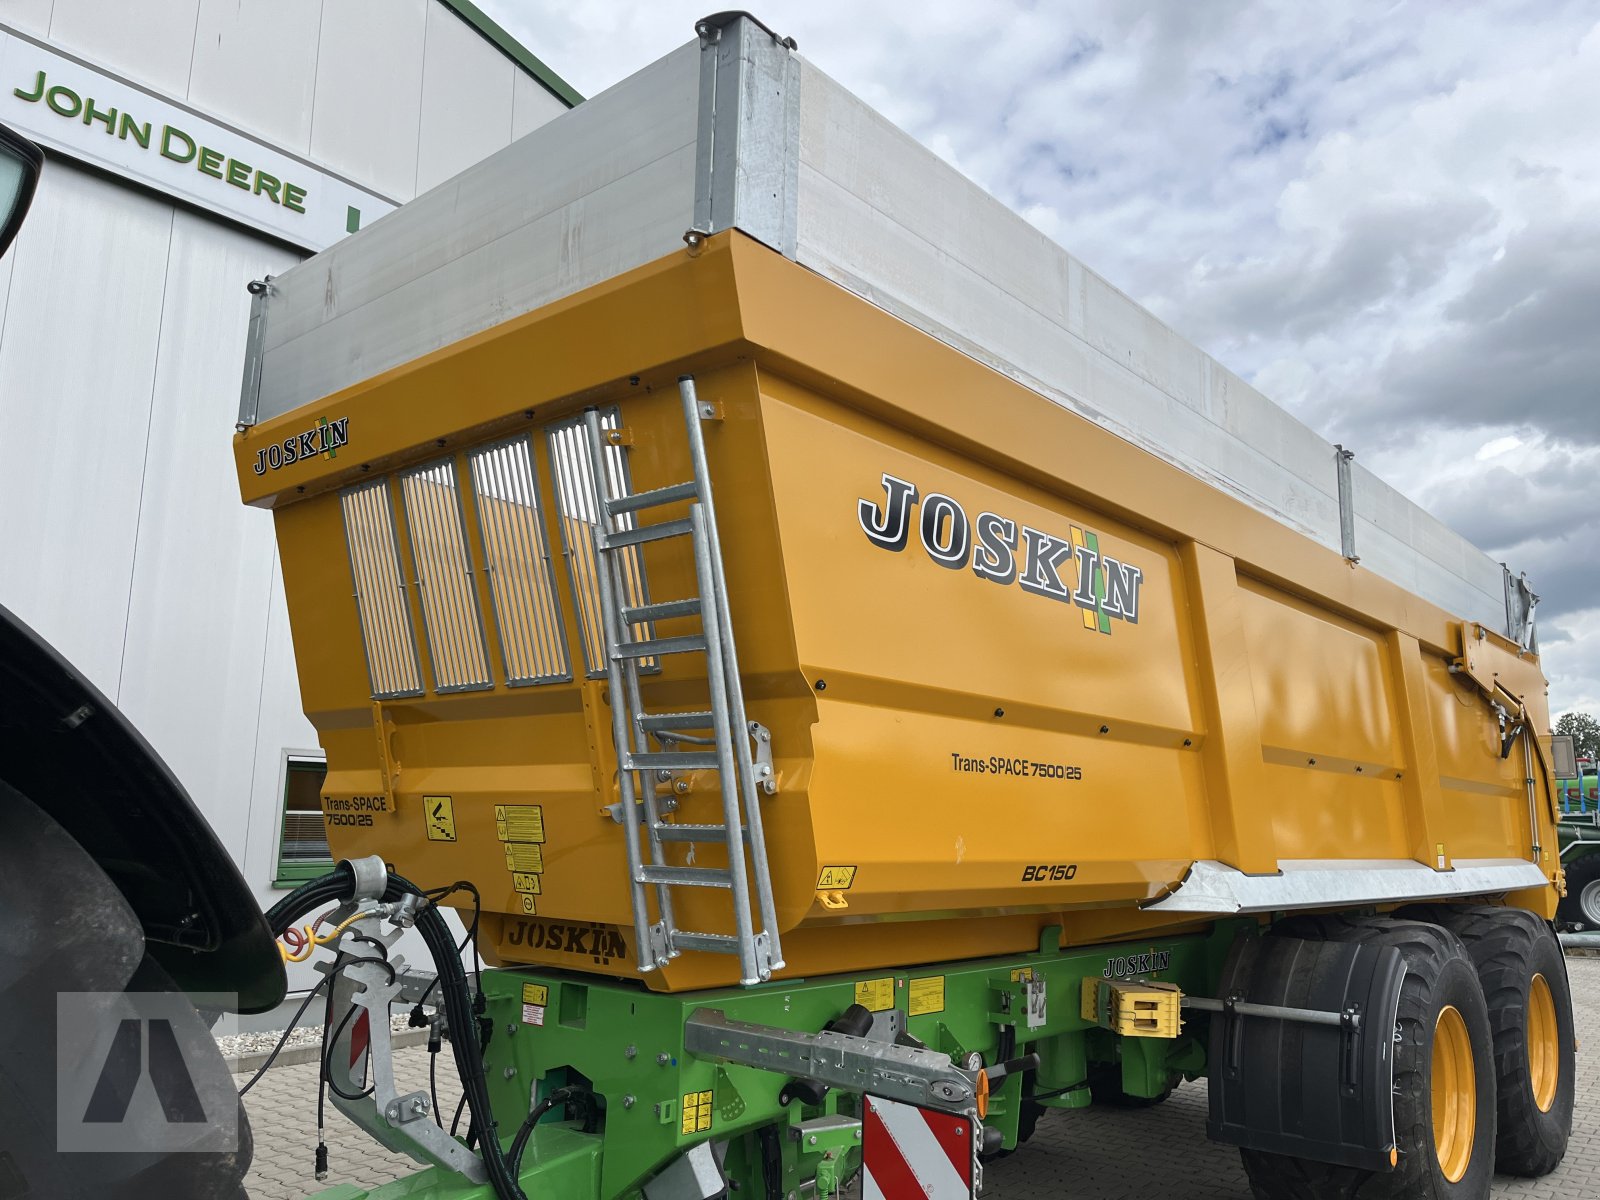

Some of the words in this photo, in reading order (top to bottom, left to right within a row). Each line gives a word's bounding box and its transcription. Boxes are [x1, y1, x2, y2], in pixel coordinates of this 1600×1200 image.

[13, 70, 152, 149] JOHN
[160, 124, 307, 214] DEERE
[253, 416, 349, 476] JOSKIN
[856, 471, 1144, 626] JOSKIN
[951, 752, 1029, 777] Trans-SPACE
[324, 796, 387, 812] Trans-SPACE
[508, 921, 628, 961] JOSKIN
[1103, 951, 1170, 979] JOSKIN
